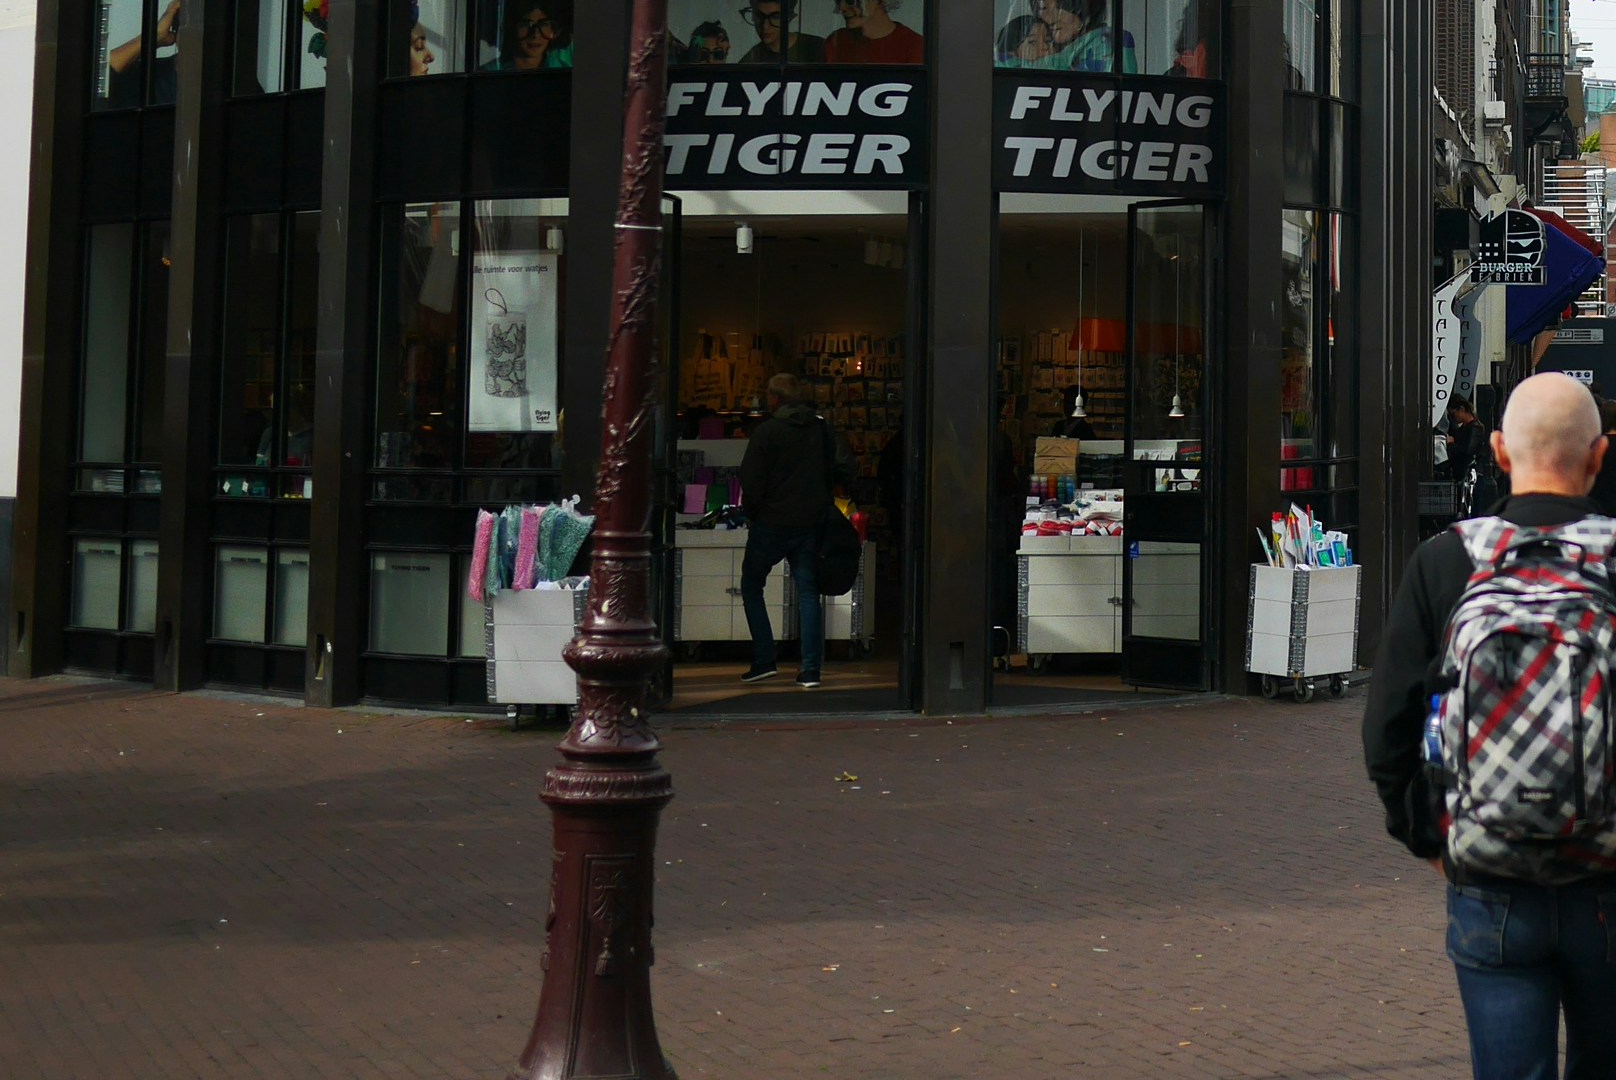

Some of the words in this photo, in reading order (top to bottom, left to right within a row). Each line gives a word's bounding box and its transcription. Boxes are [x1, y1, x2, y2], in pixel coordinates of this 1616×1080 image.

[666, 82, 913, 118] FLYING
[1010, 86, 1214, 128] FLYING
[663, 133, 911, 175] TIGER
[1004, 136, 1214, 183] TIGER
[1479, 273, 1533, 281] FABRIEK
[1480, 263, 1533, 272] BURGER
[1436, 299, 1448, 400] TATTOO
[1460, 304, 1471, 391] TATTOO
